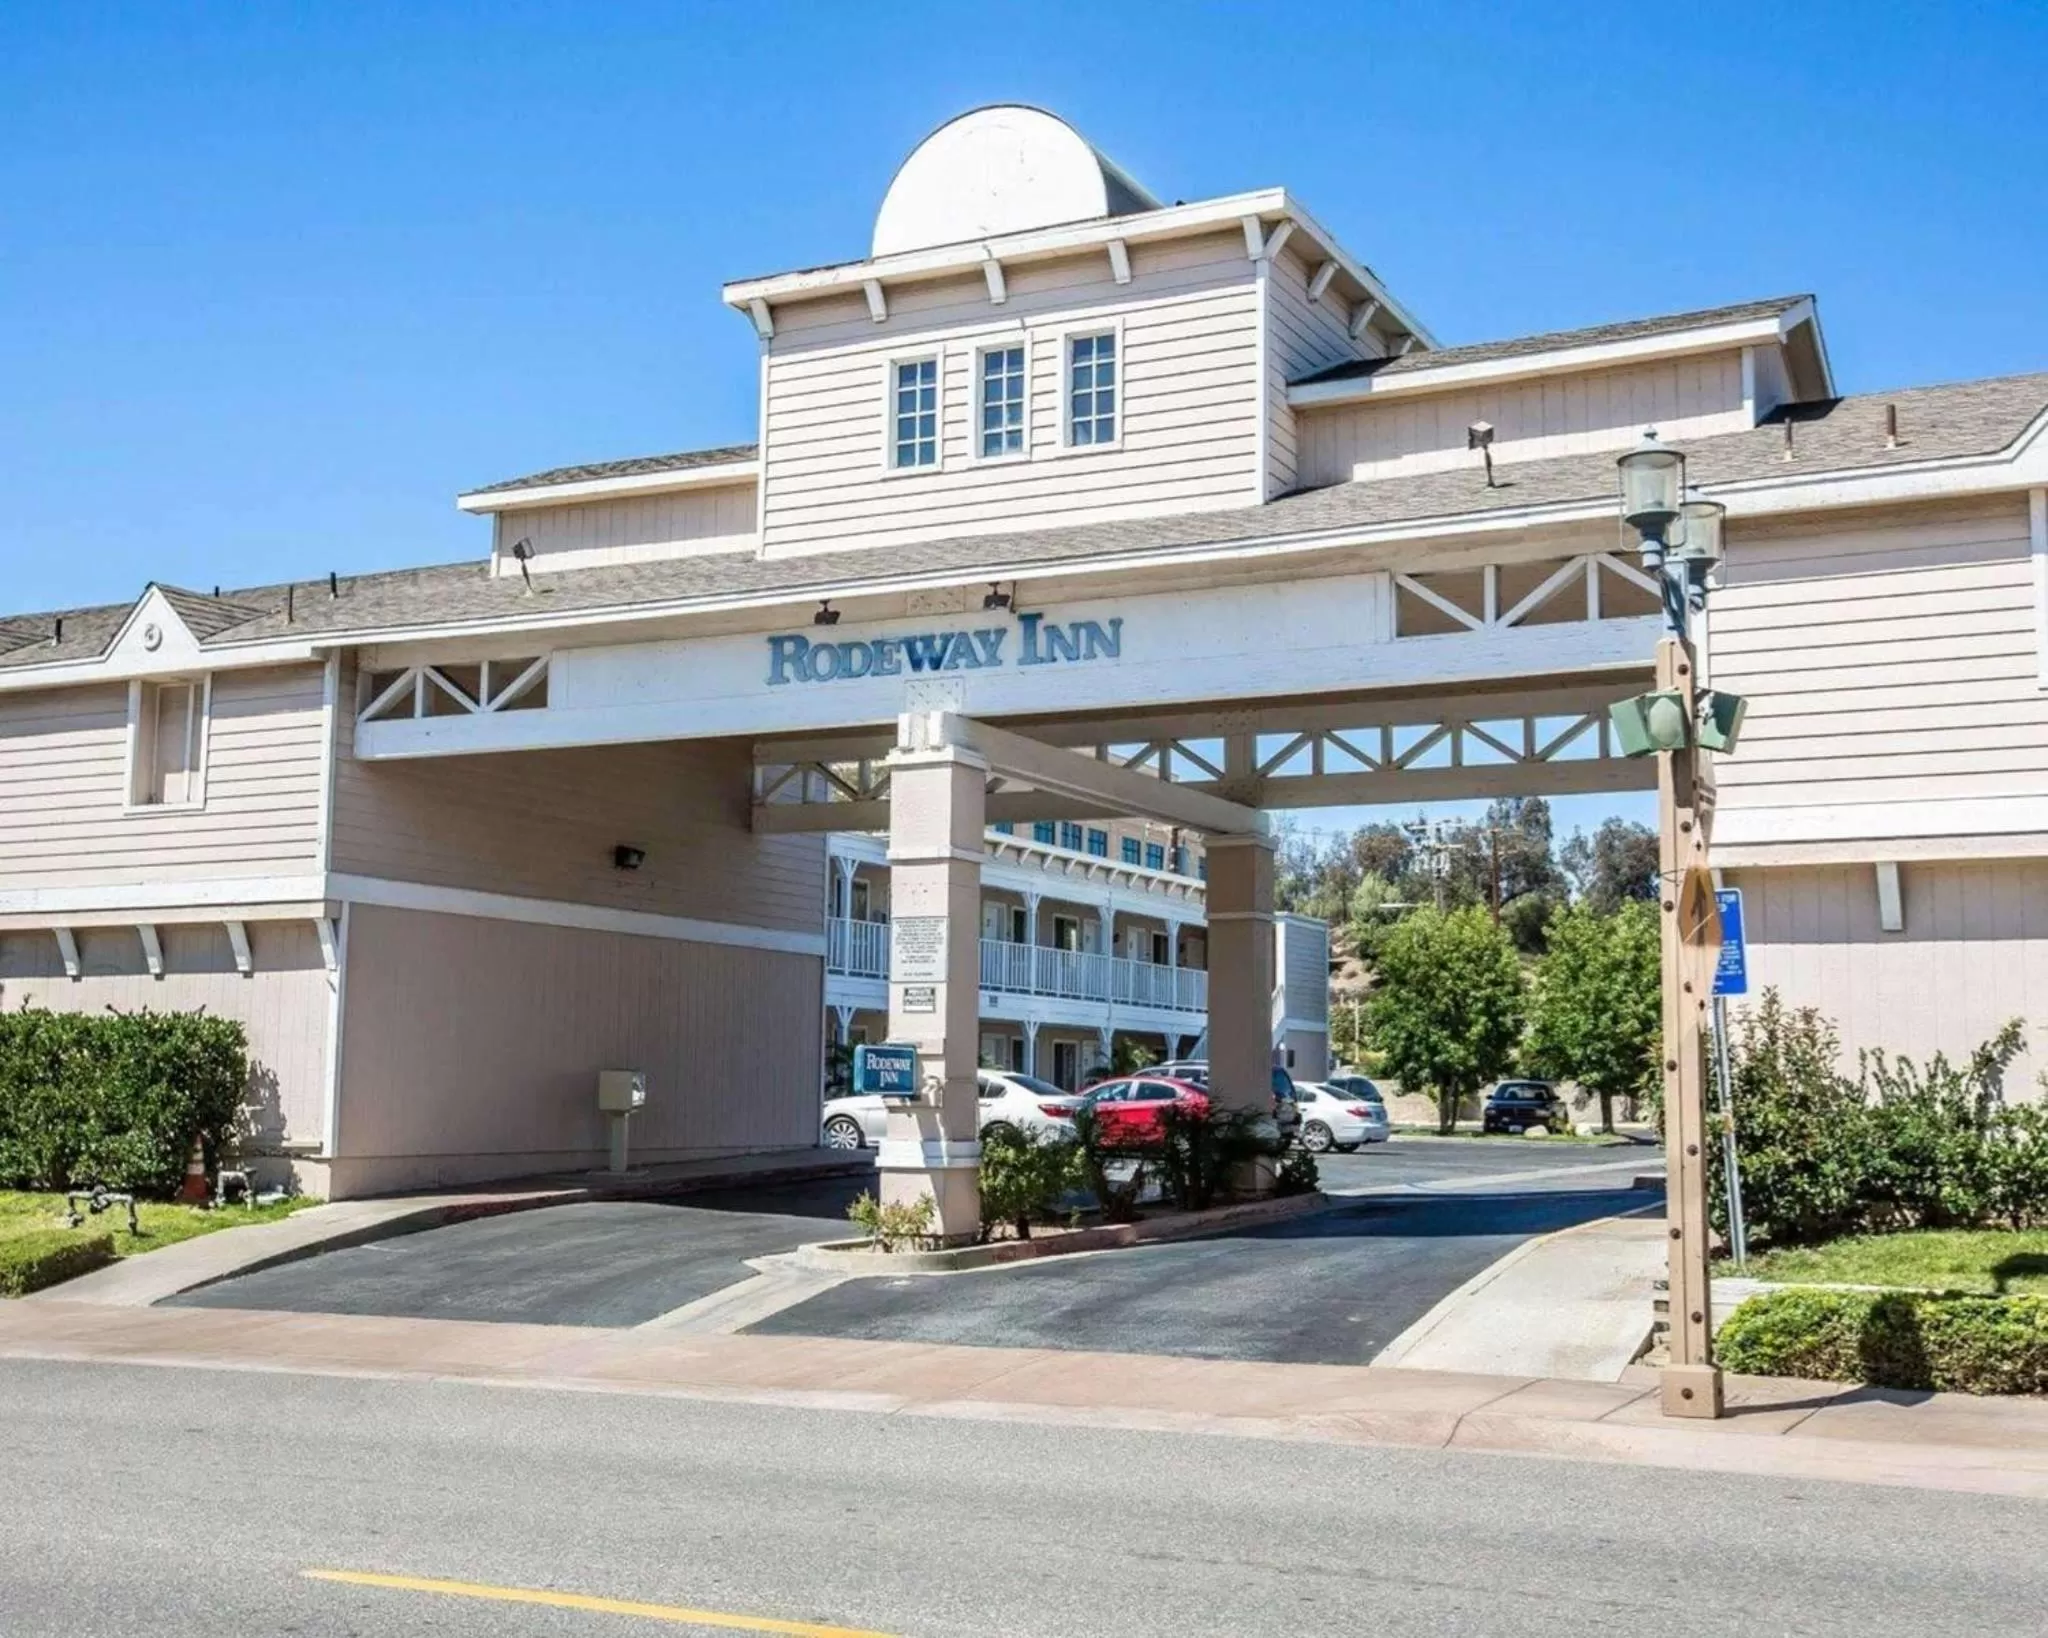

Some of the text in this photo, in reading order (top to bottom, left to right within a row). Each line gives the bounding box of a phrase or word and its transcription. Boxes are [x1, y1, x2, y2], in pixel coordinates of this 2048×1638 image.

[766, 612, 1123, 686] RODEWAY INN
[867, 1053, 912, 1070] RODEWAY
[880, 1071, 898, 1087] INN
